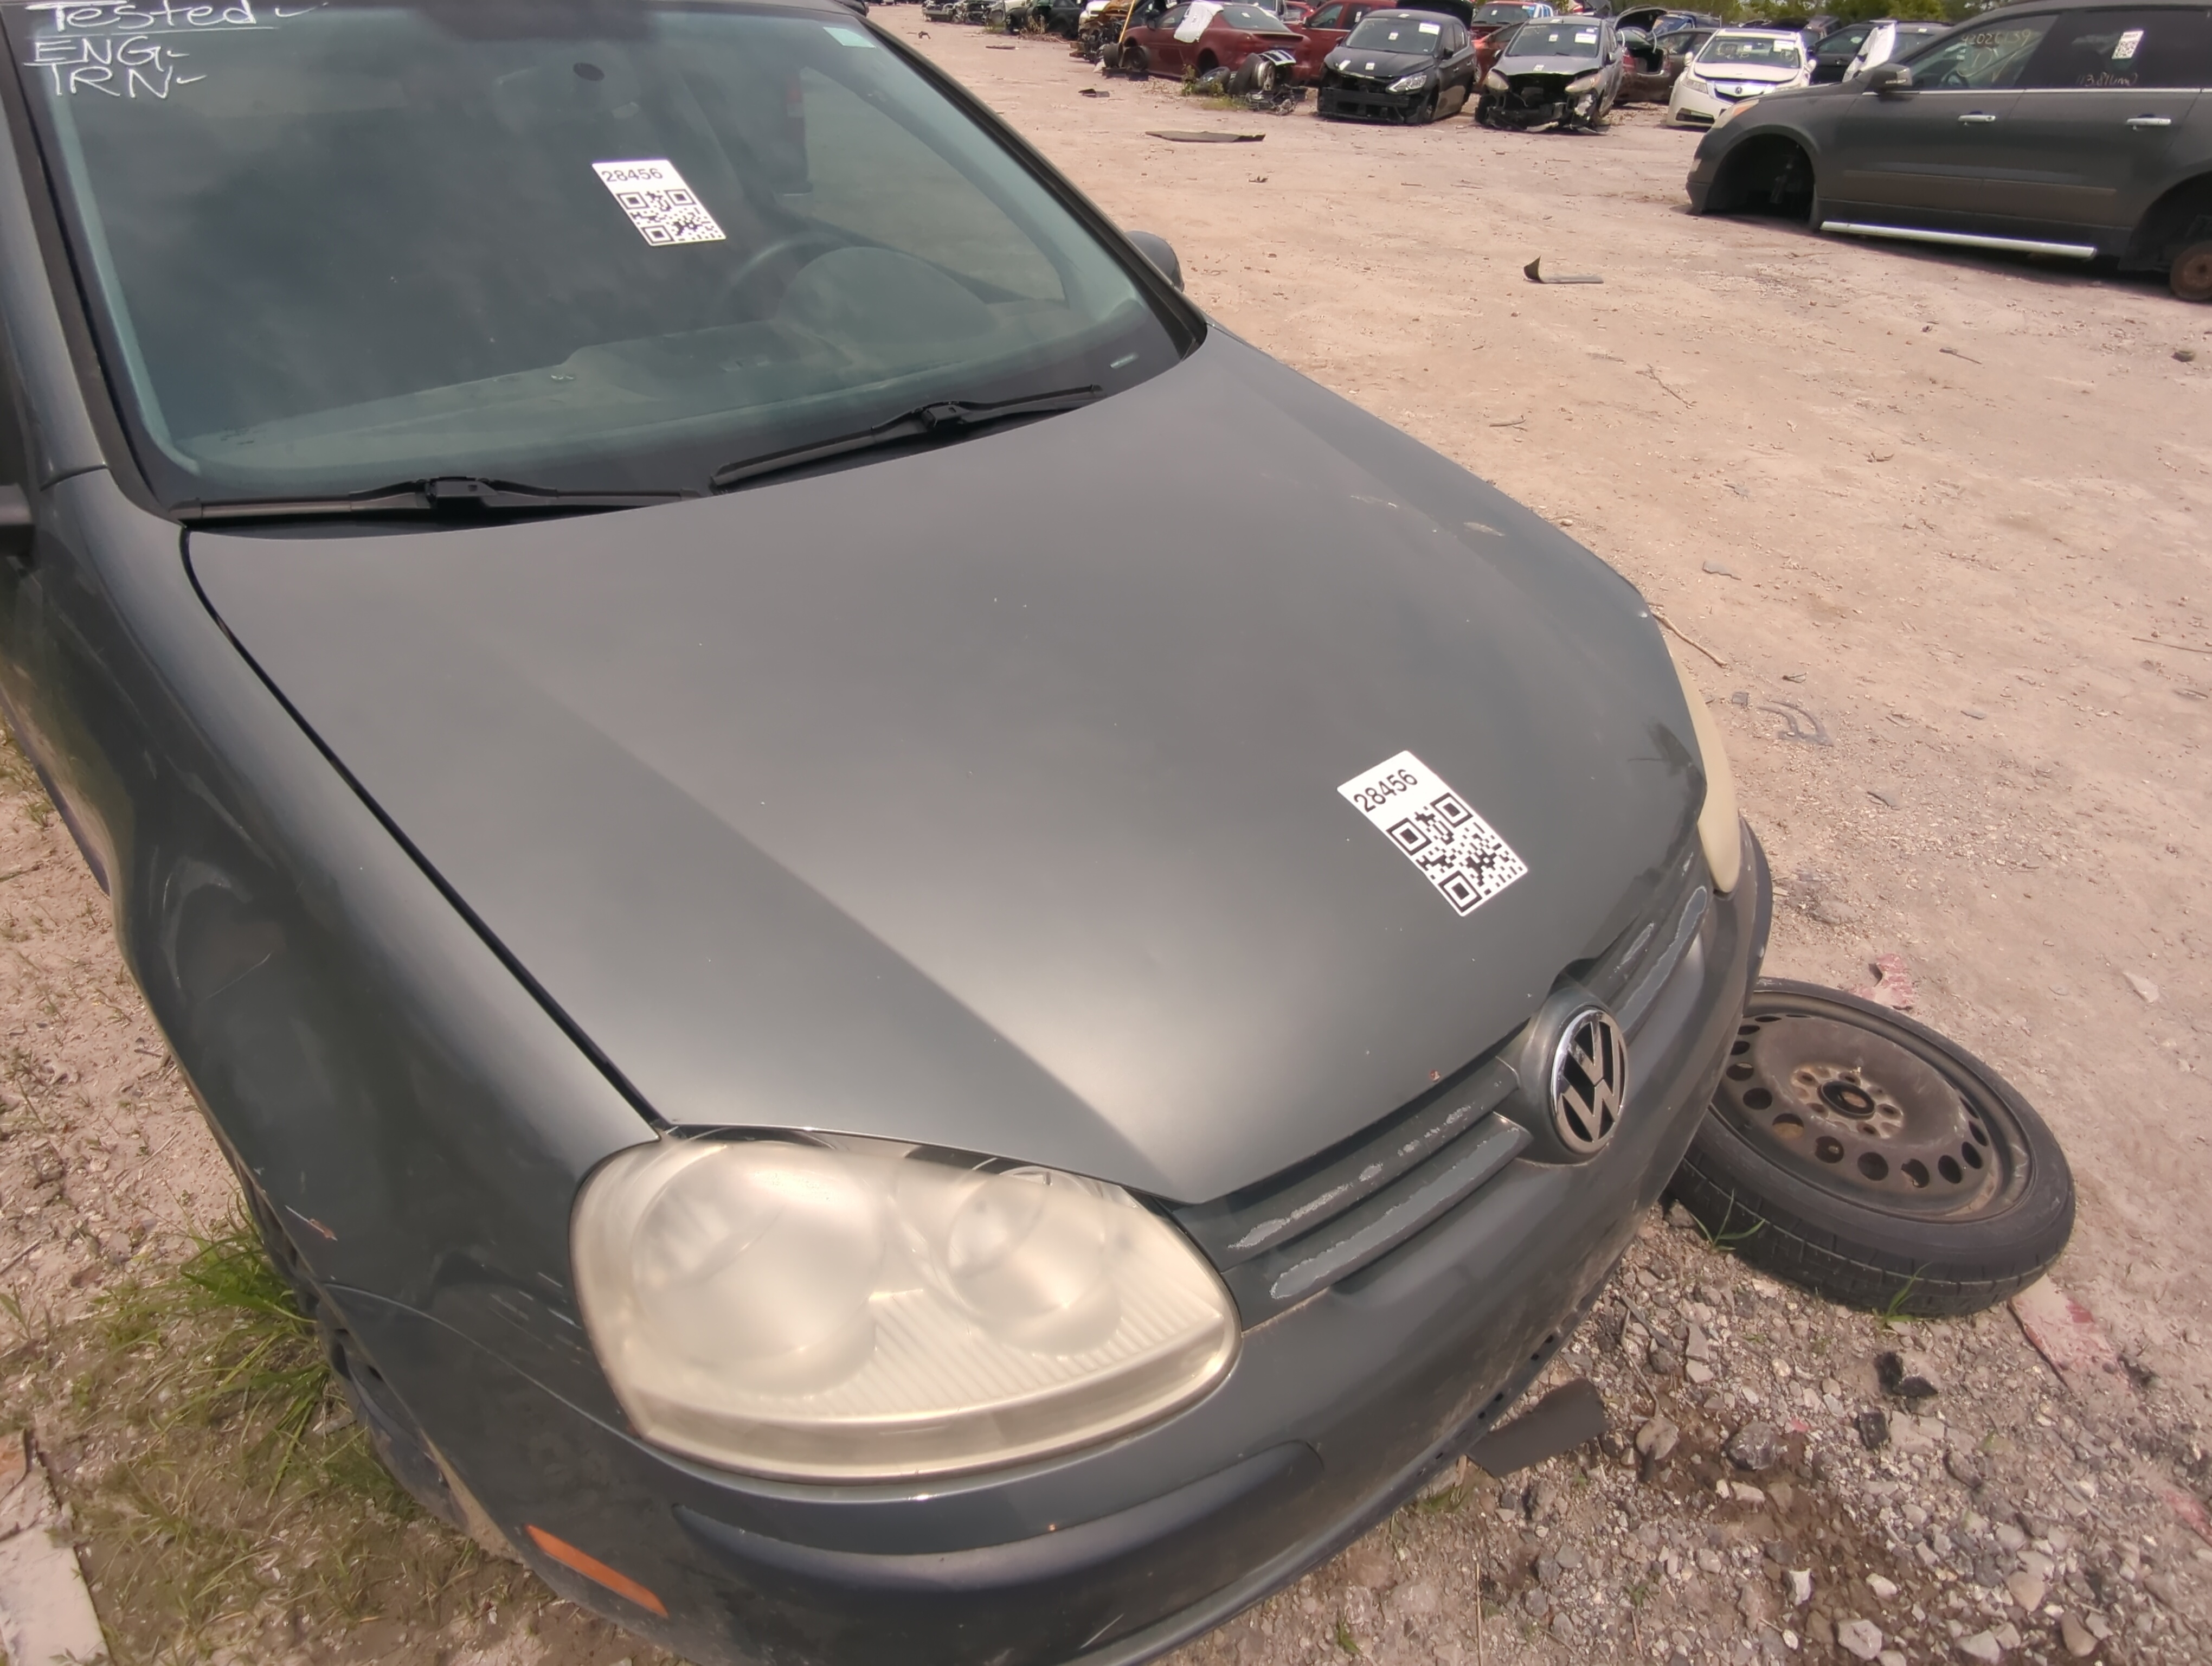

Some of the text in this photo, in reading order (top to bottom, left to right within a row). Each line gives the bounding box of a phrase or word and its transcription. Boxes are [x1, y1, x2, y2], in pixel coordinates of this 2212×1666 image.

[25, 0, 256, 32] Tested
[601, 168, 663, 182] 28456
[1353, 769, 1418, 812] 28456
